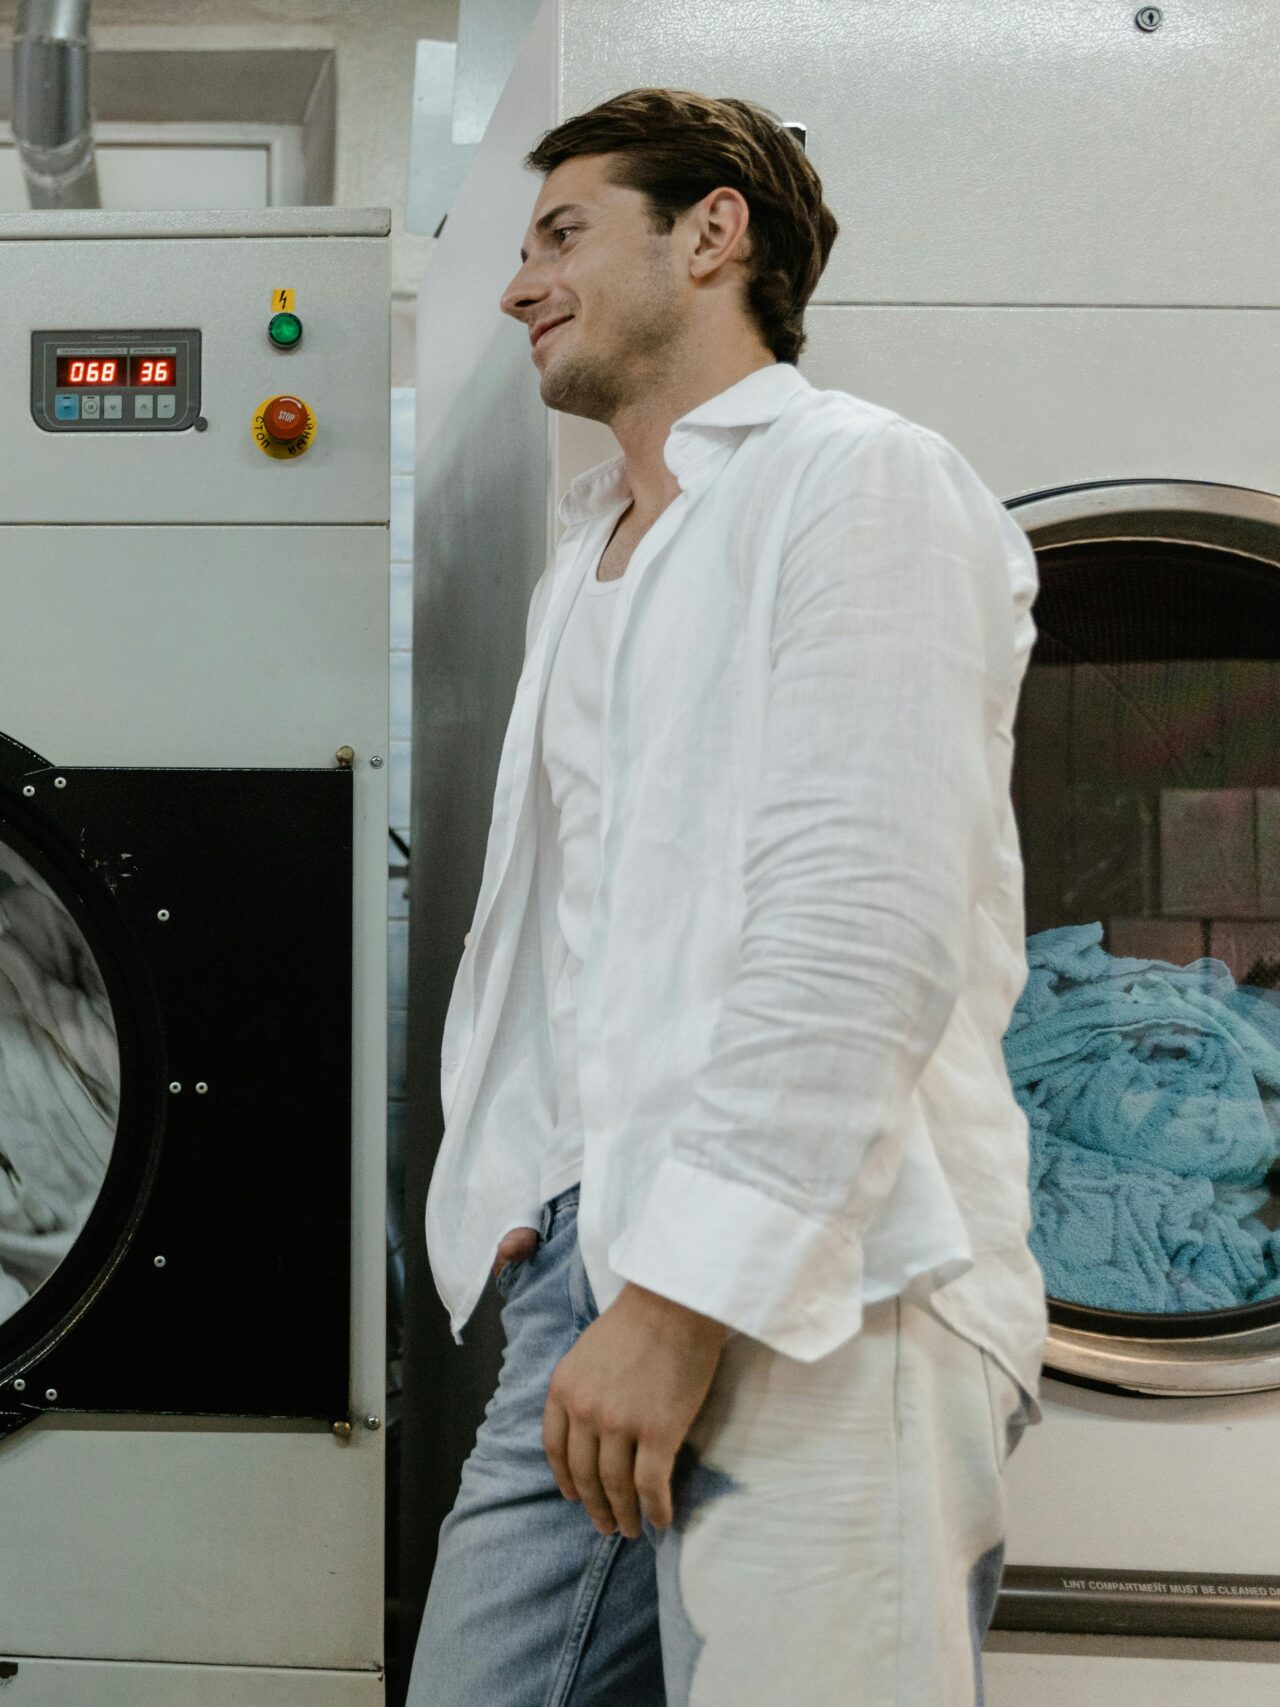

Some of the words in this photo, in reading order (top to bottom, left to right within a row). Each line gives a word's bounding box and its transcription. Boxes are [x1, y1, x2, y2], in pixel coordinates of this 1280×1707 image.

[70, 362, 116, 382] 068
[141, 362, 168, 382] 36
[277, 410, 296, 423] STOP
[254, 415, 271, 449] СТОП
[1063, 1580, 1086, 1590] LINT
[1088, 1581, 1167, 1593] COMPARTMENT
[1169, 1584, 1198, 1594] MUST
[1201, 1585, 1216, 1594] BE
[1218, 1586, 1267, 1596] CLEANED
